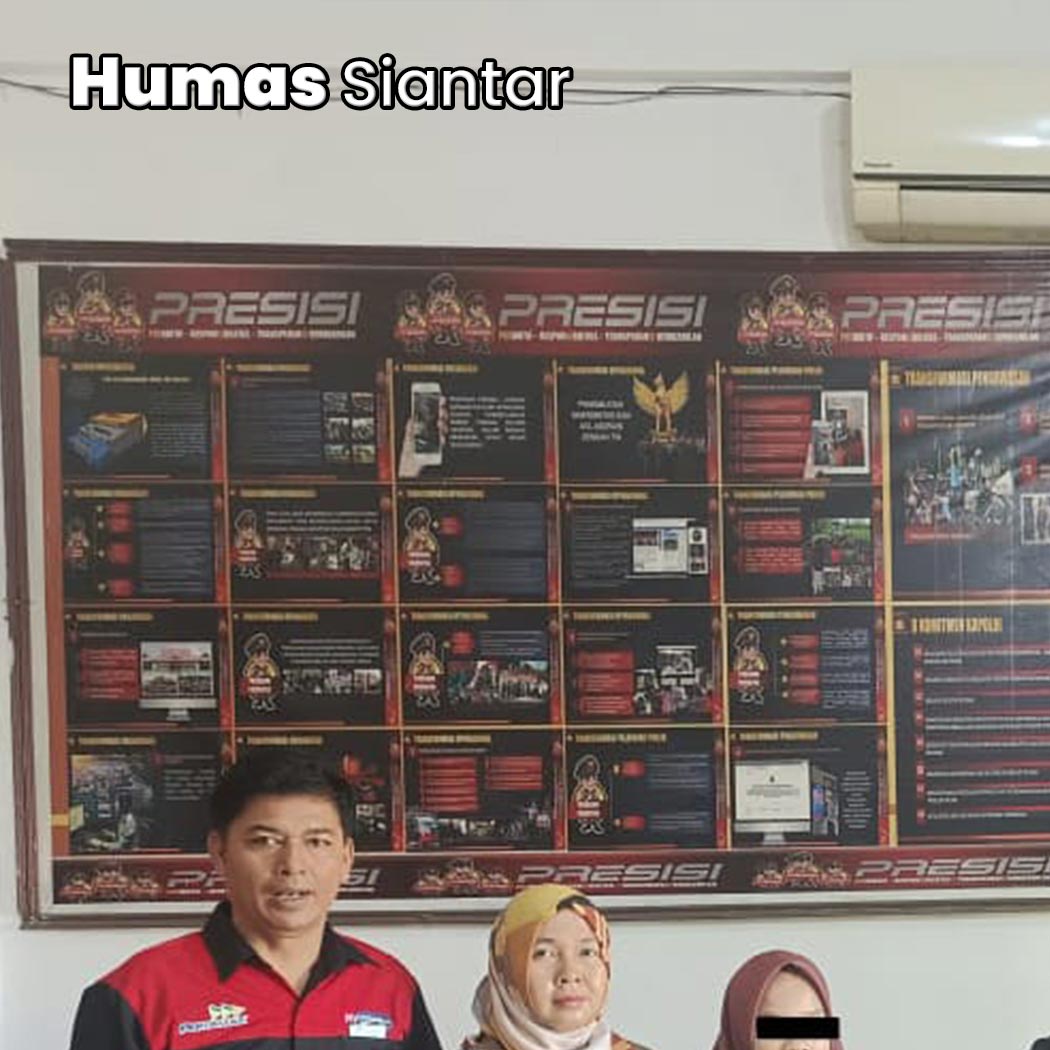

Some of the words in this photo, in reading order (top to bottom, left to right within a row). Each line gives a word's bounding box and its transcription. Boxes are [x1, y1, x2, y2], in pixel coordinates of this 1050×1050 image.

[151, 291, 360, 326] PRESISI
[500, 293, 707, 328] PRESISI
[842, 295, 1045, 329] PRESISI
[517, 863, 725, 882] PRESISI
